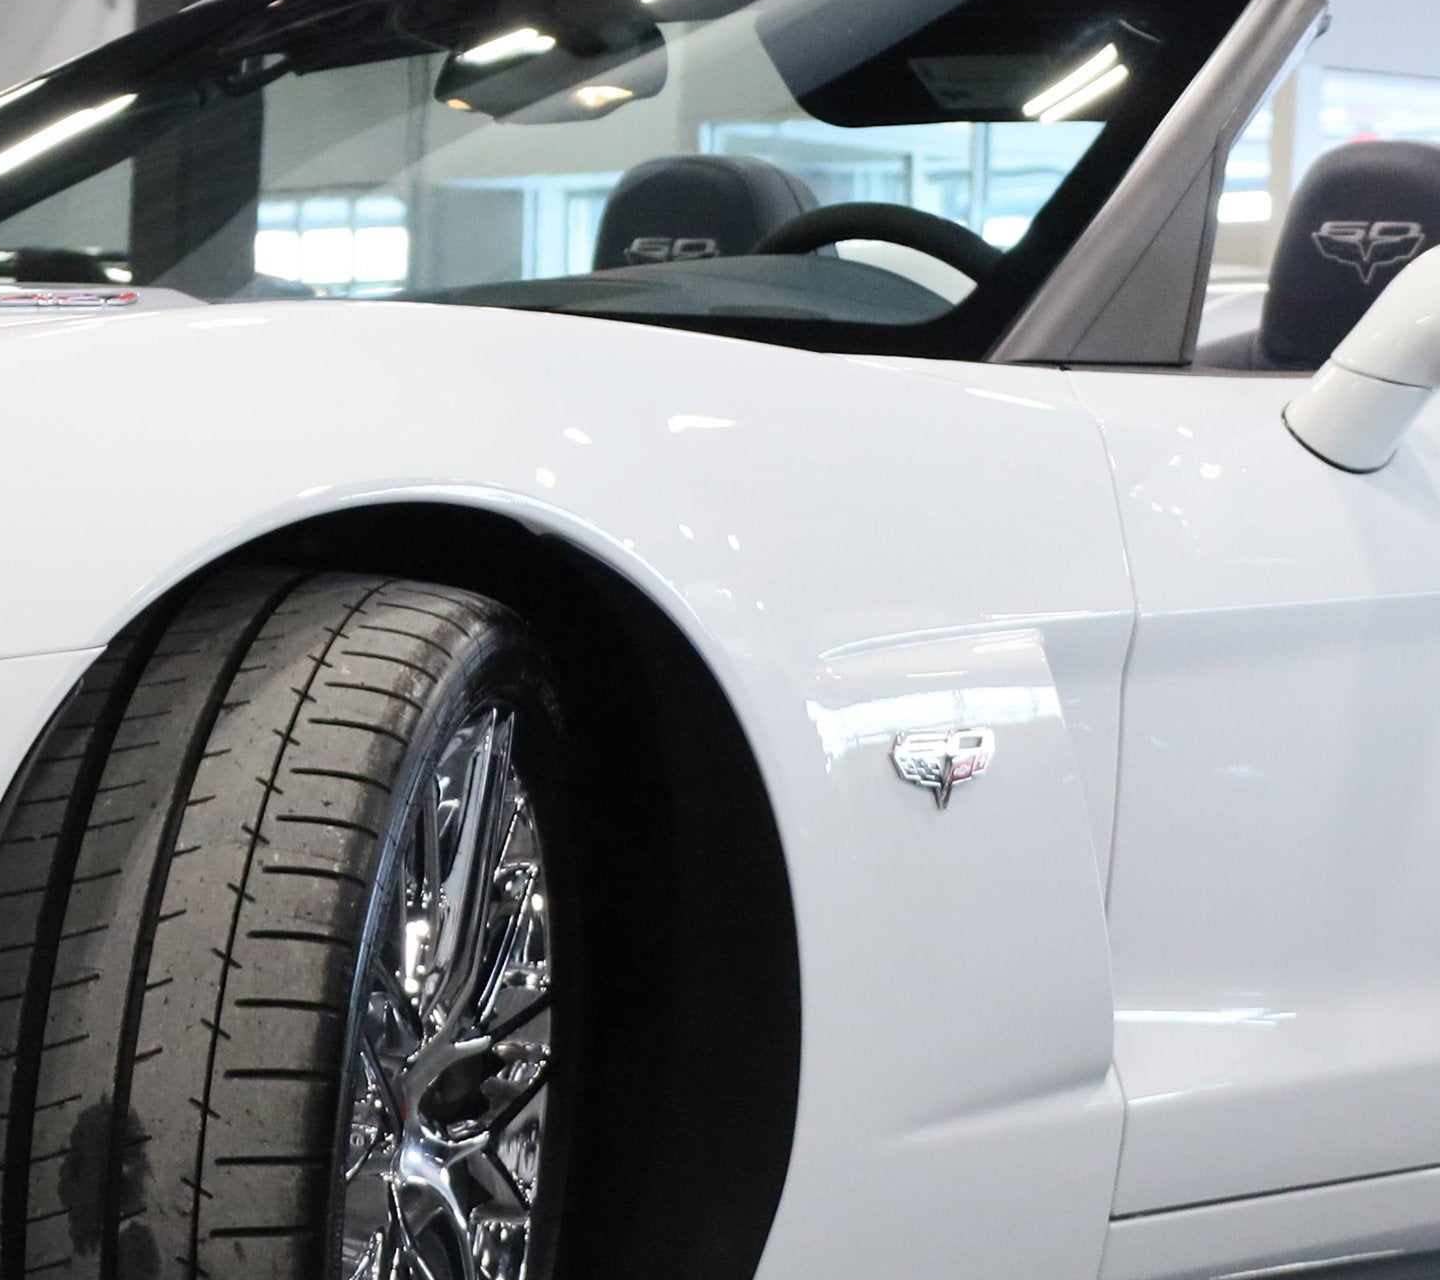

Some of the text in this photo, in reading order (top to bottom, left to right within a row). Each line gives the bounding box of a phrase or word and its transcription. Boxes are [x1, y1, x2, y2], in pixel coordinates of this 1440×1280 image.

[1320, 221, 1422, 241] 60
[630, 237, 717, 259] 60
[895, 727, 995, 760] 60
